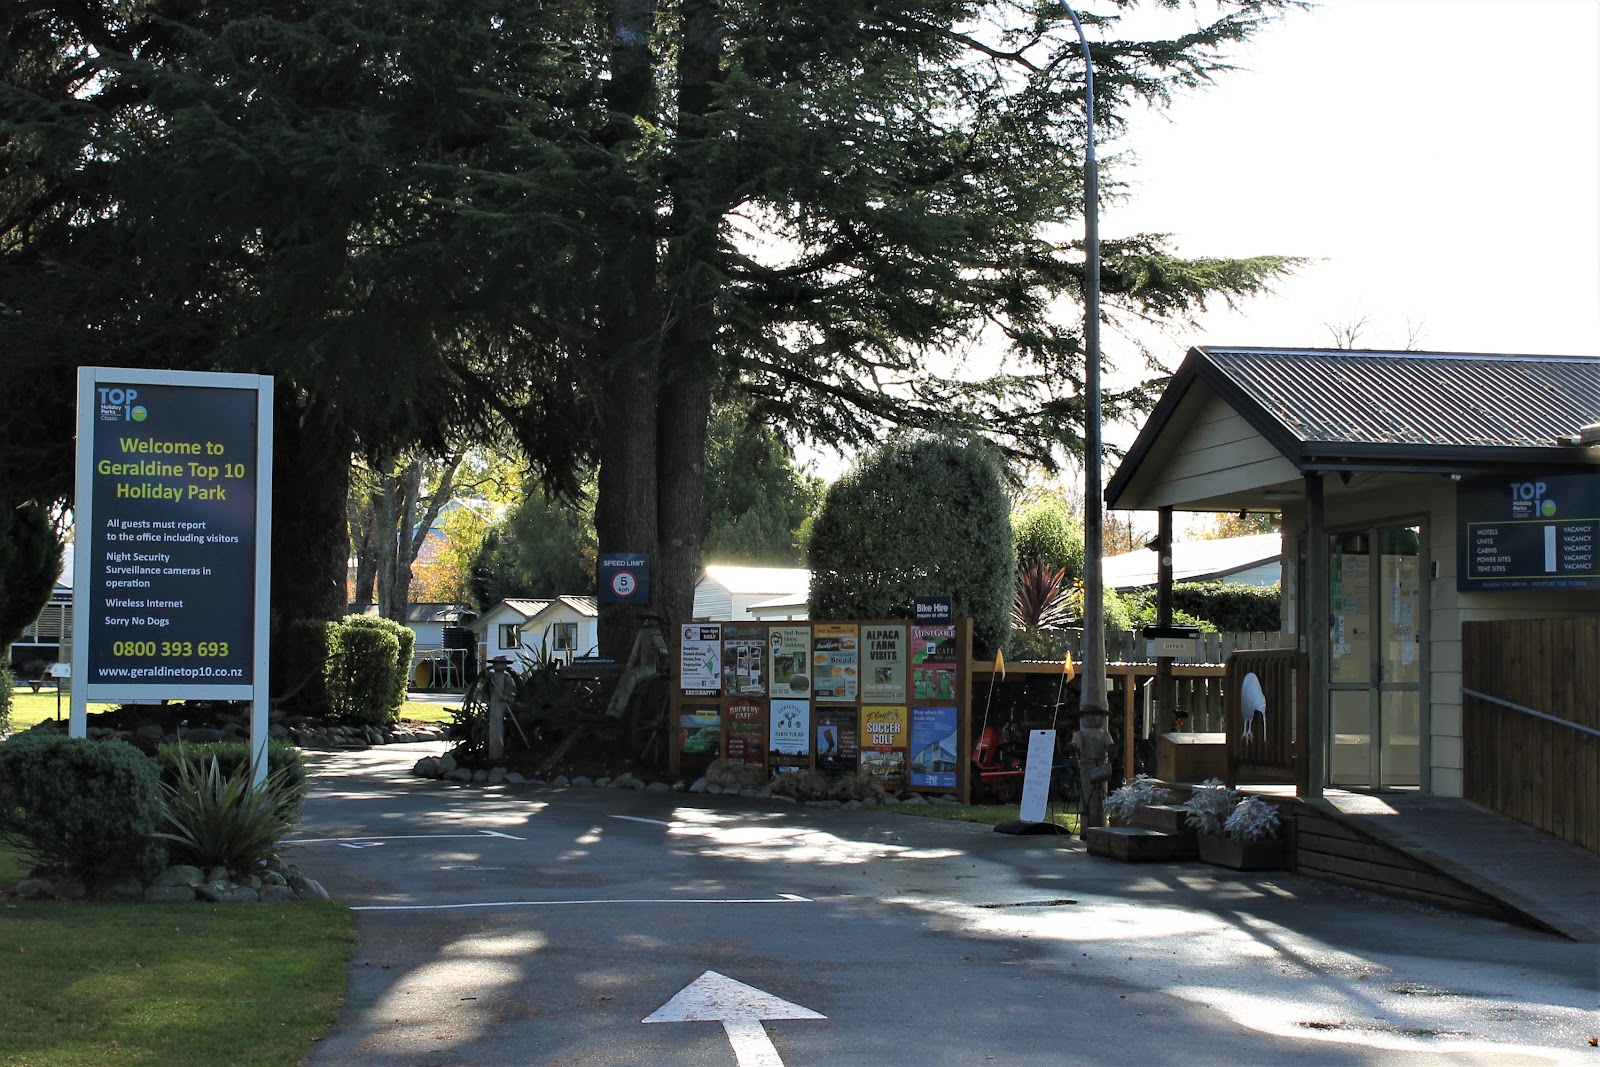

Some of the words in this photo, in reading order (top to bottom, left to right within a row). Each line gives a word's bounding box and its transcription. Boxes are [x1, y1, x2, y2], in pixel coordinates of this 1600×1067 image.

[98, 388, 138, 405] TOP
[101, 404, 122, 412] Holiday
[125, 405, 148, 422] 10
[119, 438, 202, 455] Welcome
[206, 441, 225, 456] to
[98, 460, 183, 477] Geraldine
[187, 462, 219, 481] Top
[224, 463, 245, 479] 10
[117, 483, 183, 503] Holiday
[188, 485, 226, 500] Park
[1510, 482, 1547, 500] TOP
[1535, 499, 1557, 517] 10
[106, 519, 120, 528] All
[121, 519, 151, 530] guests
[152, 520, 176, 529] must
[177, 521, 207, 531] report
[1477, 528, 1499, 536] MOTELS
[107, 533, 117, 541] to
[119, 532, 135, 541] the
[136, 533, 162, 542] office
[163, 533, 205, 544] including
[206, 534, 239, 544] visitors
[1563, 544, 1592, 552] VACANCY
[106, 552, 131, 563] Night
[133, 552, 170, 563] Security
[105, 565, 161, 575] Surveillance
[163, 567, 201, 576] cameras
[202, 566, 212, 576] in
[105, 578, 151, 589] operation
[620, 576, 628, 587] 5
[105, 598, 145, 608] Wireless
[146, 599, 184, 609] Internet
[917, 604, 932, 612] Bike
[933, 604, 948, 612] Hire
[105, 616, 130, 627] Sorry
[131, 617, 145, 626] No
[147, 617, 170, 627] Dogs
[866, 630, 900, 640] ALPACA
[914, 629, 934, 639] MINI
[934, 628, 955, 638] GOLF
[113, 641, 157, 657] 0800
[161, 641, 193, 657] 393
[197, 641, 229, 657] 693
[871, 640, 896, 650] FARM
[830, 656, 856, 664] Breads
[870, 650, 897, 660] VISITS
[99, 667, 243, 679] www.geraldinetop10.co.nz
[729, 705, 759, 715] BREWERY
[913, 709, 924, 717] Shop
[866, 722, 901, 733] SOCCER
[872, 733, 895, 745] GOLF
